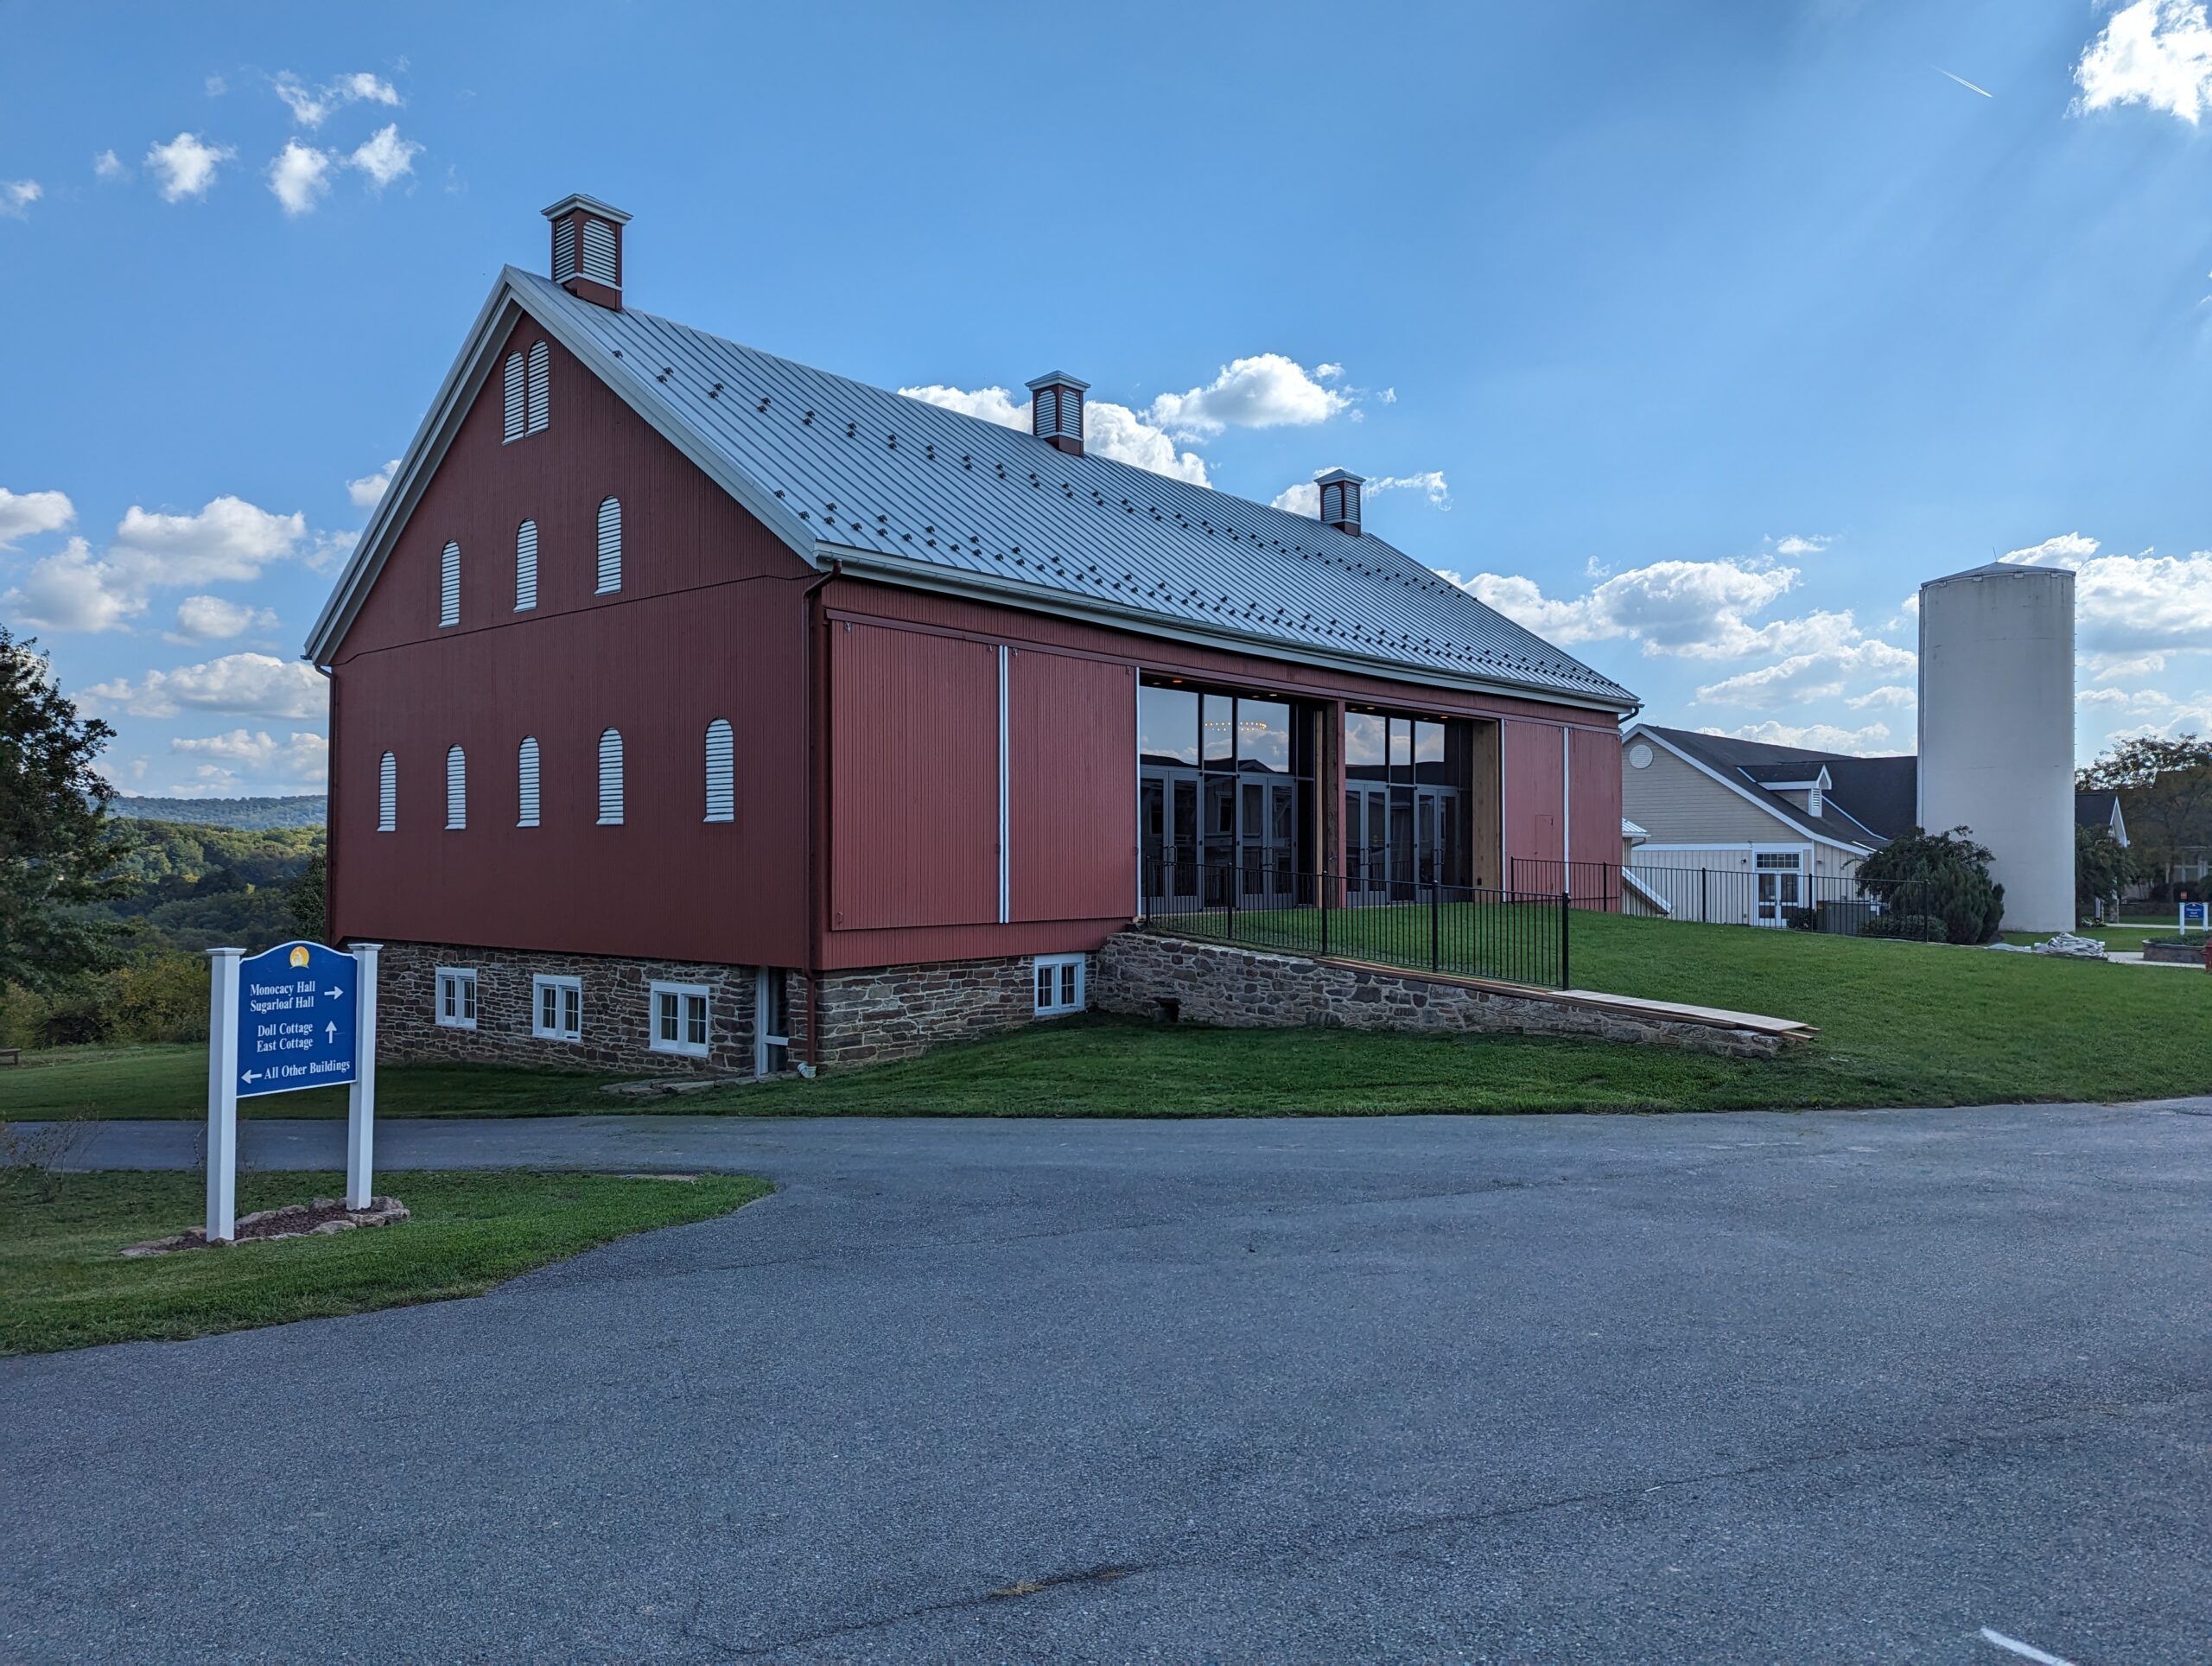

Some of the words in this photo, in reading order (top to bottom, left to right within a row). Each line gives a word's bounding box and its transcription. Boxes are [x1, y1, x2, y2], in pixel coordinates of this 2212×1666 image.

[250, 983, 294, 996] Monocacy
[296, 981, 315, 993] Hall
[250, 997, 294, 1014] Sugarloaf
[296, 996, 315, 1008] Hall
[257, 1024, 276, 1037] Doll
[279, 1022, 314, 1035] Cottage
[257, 1040, 276, 1052] East
[279, 1038, 314, 1050] Cottage
[264, 1066, 279, 1079] All
[281, 1064, 307, 1078] Other
[309, 1059, 351, 1073] Buildings
